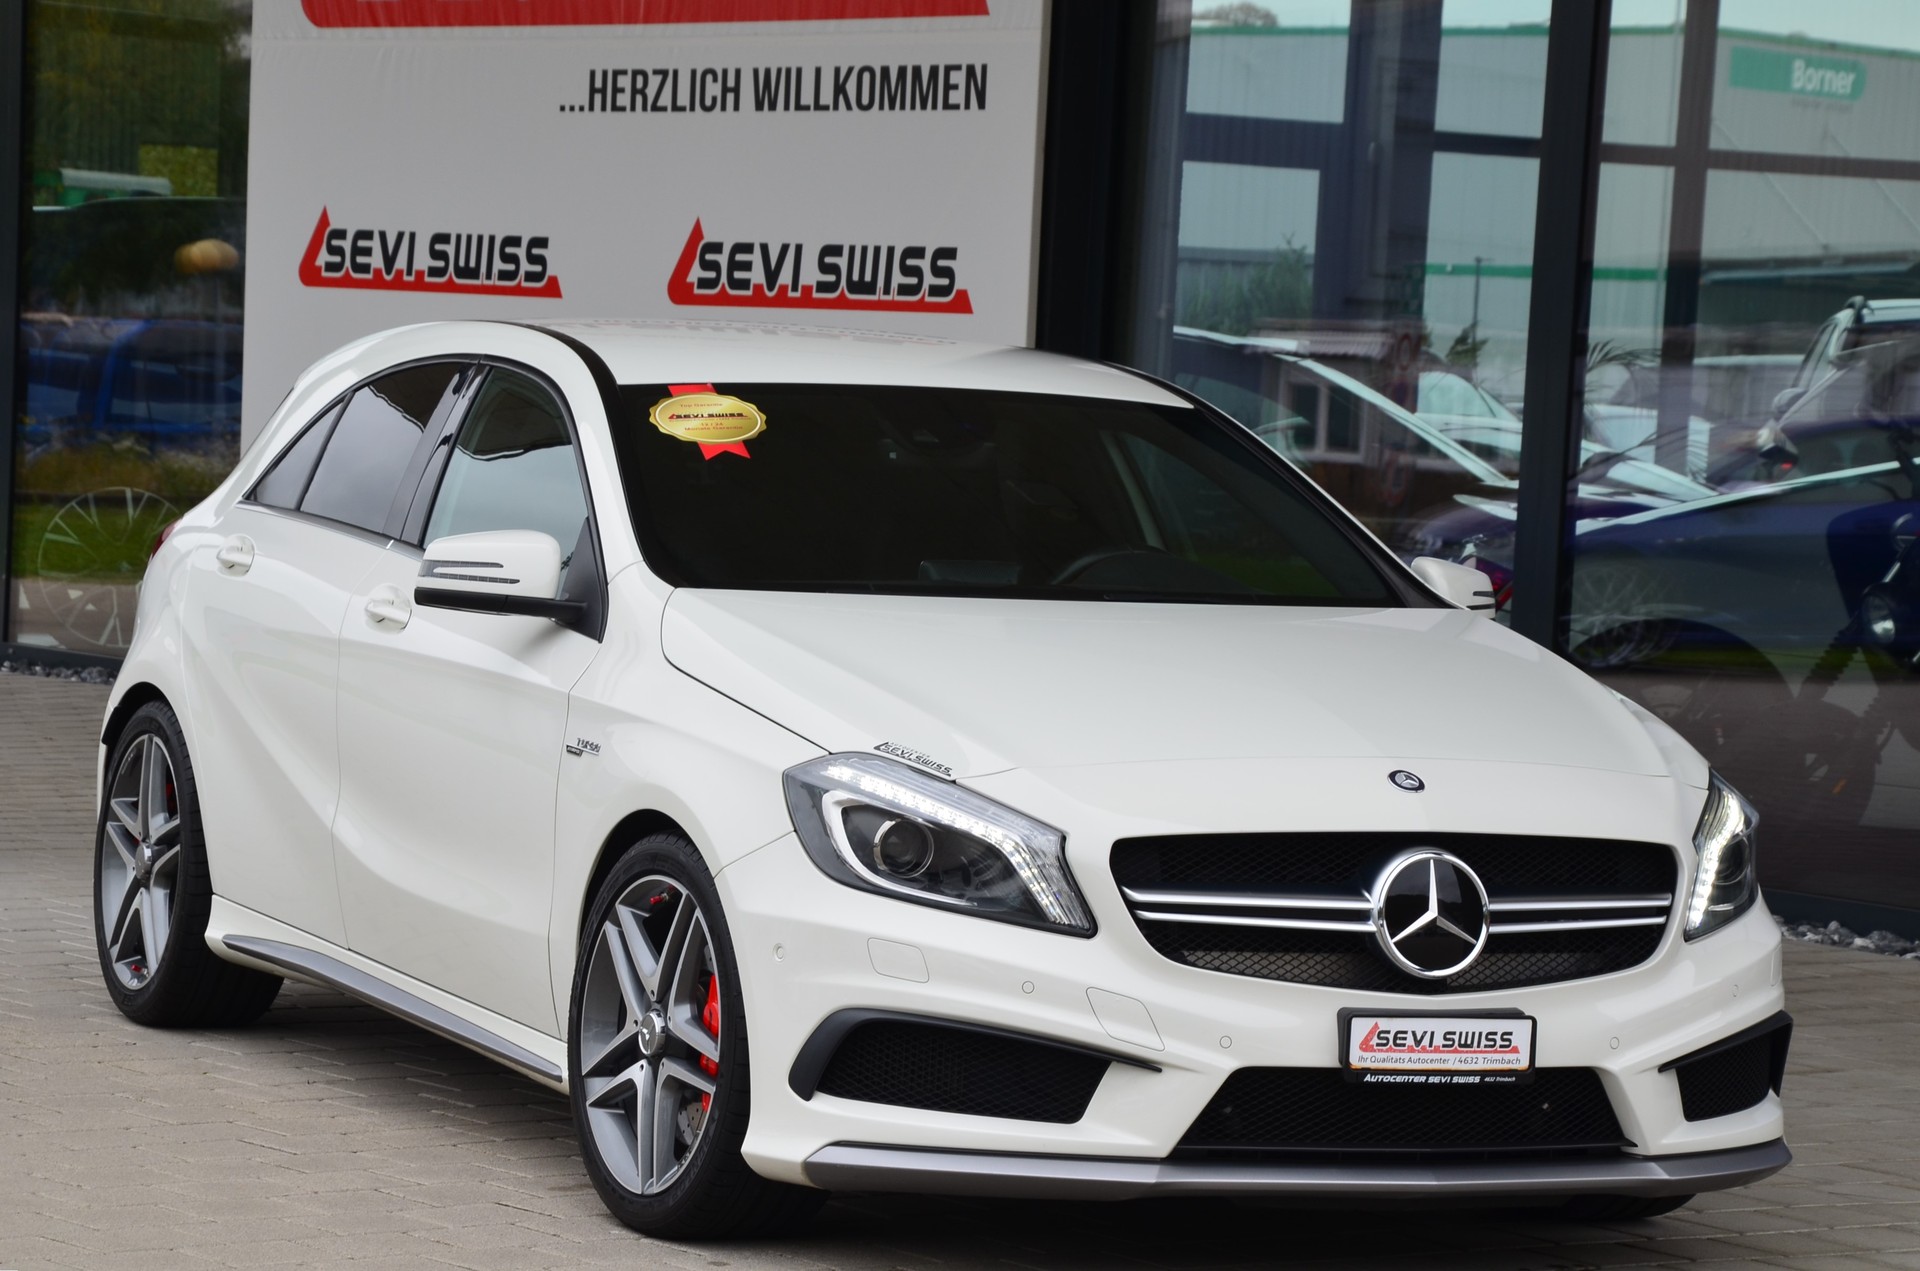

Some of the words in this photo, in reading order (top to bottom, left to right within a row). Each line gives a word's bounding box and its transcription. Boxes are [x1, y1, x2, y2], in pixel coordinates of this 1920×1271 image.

[752, 62, 989, 112] WILLKOMMEN
[1791, 58, 1856, 95] Borner
[323, 227, 416, 278] SEVI
[426, 231, 550, 284] SWISS
[695, 240, 804, 297] SEVI
[814, 243, 959, 299] SWISS
[881, 744, 914, 759] SEVI
[912, 755, 953, 774] SWISS
[1375, 1029, 1435, 1049] SEVI
[1442, 1031, 1514, 1049] SWISS
[1357, 1055, 1369, 1063] Ihr
[1407, 1056, 1450, 1065] Autocenter
[1457, 1057, 1479, 1065] 4632
[1482, 1056, 1521, 1065] Trimbach
[1363, 1073, 1426, 1083] AUTOCENTER
[1427, 1075, 1451, 1084] SEVI
[1451, 1075, 1481, 1084] SWISS
